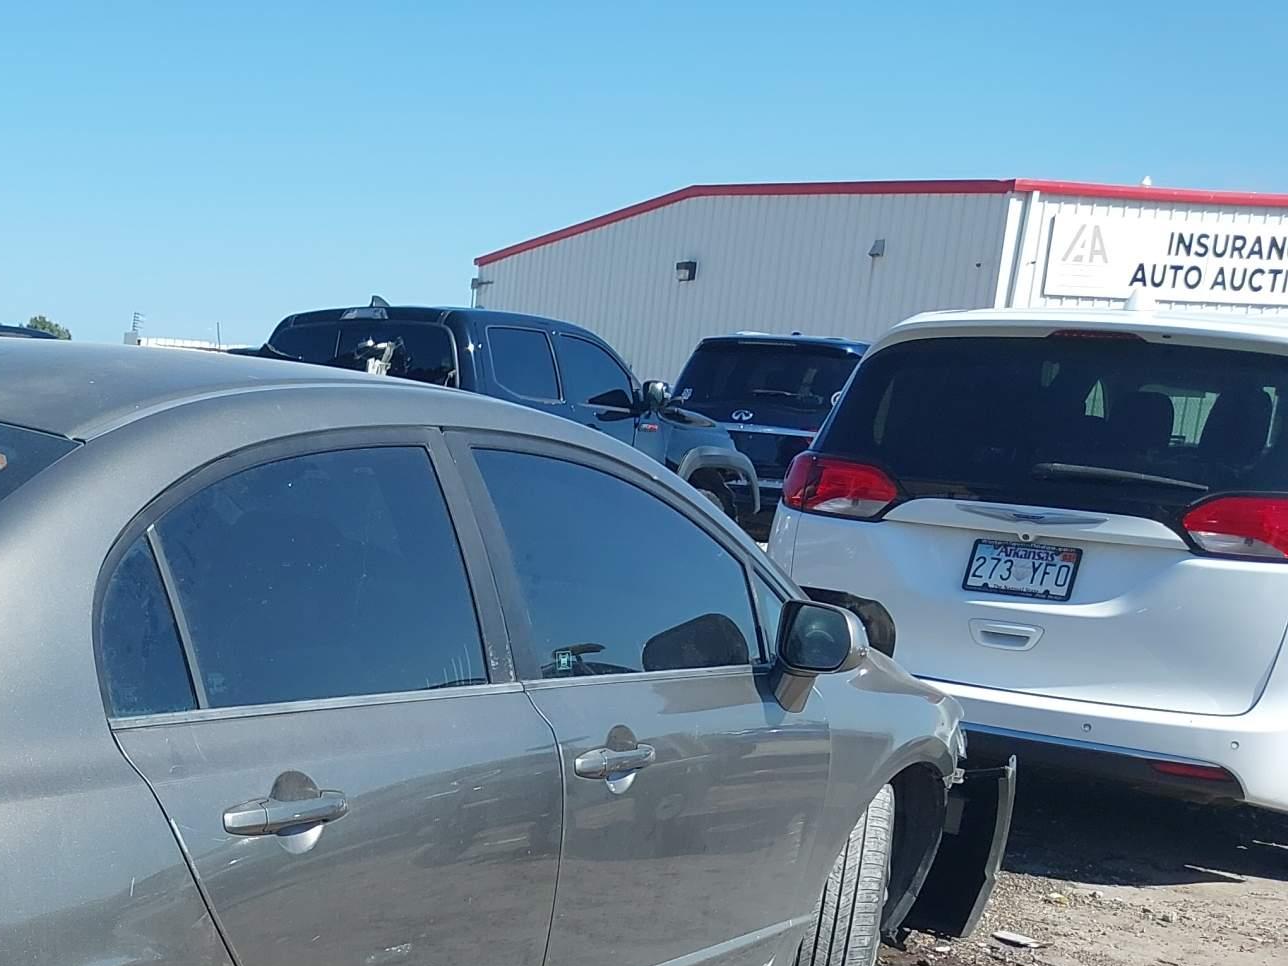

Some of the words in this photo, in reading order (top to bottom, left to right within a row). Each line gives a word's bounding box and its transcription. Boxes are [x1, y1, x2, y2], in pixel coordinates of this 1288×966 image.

[1167, 231, 1288, 260] INSURAN
[1128, 263, 1203, 290] AUTO
[1210, 267, 1288, 293] AUCTI
[996, 546, 1056, 562] Arkansas
[972, 556, 1014, 581] 273
